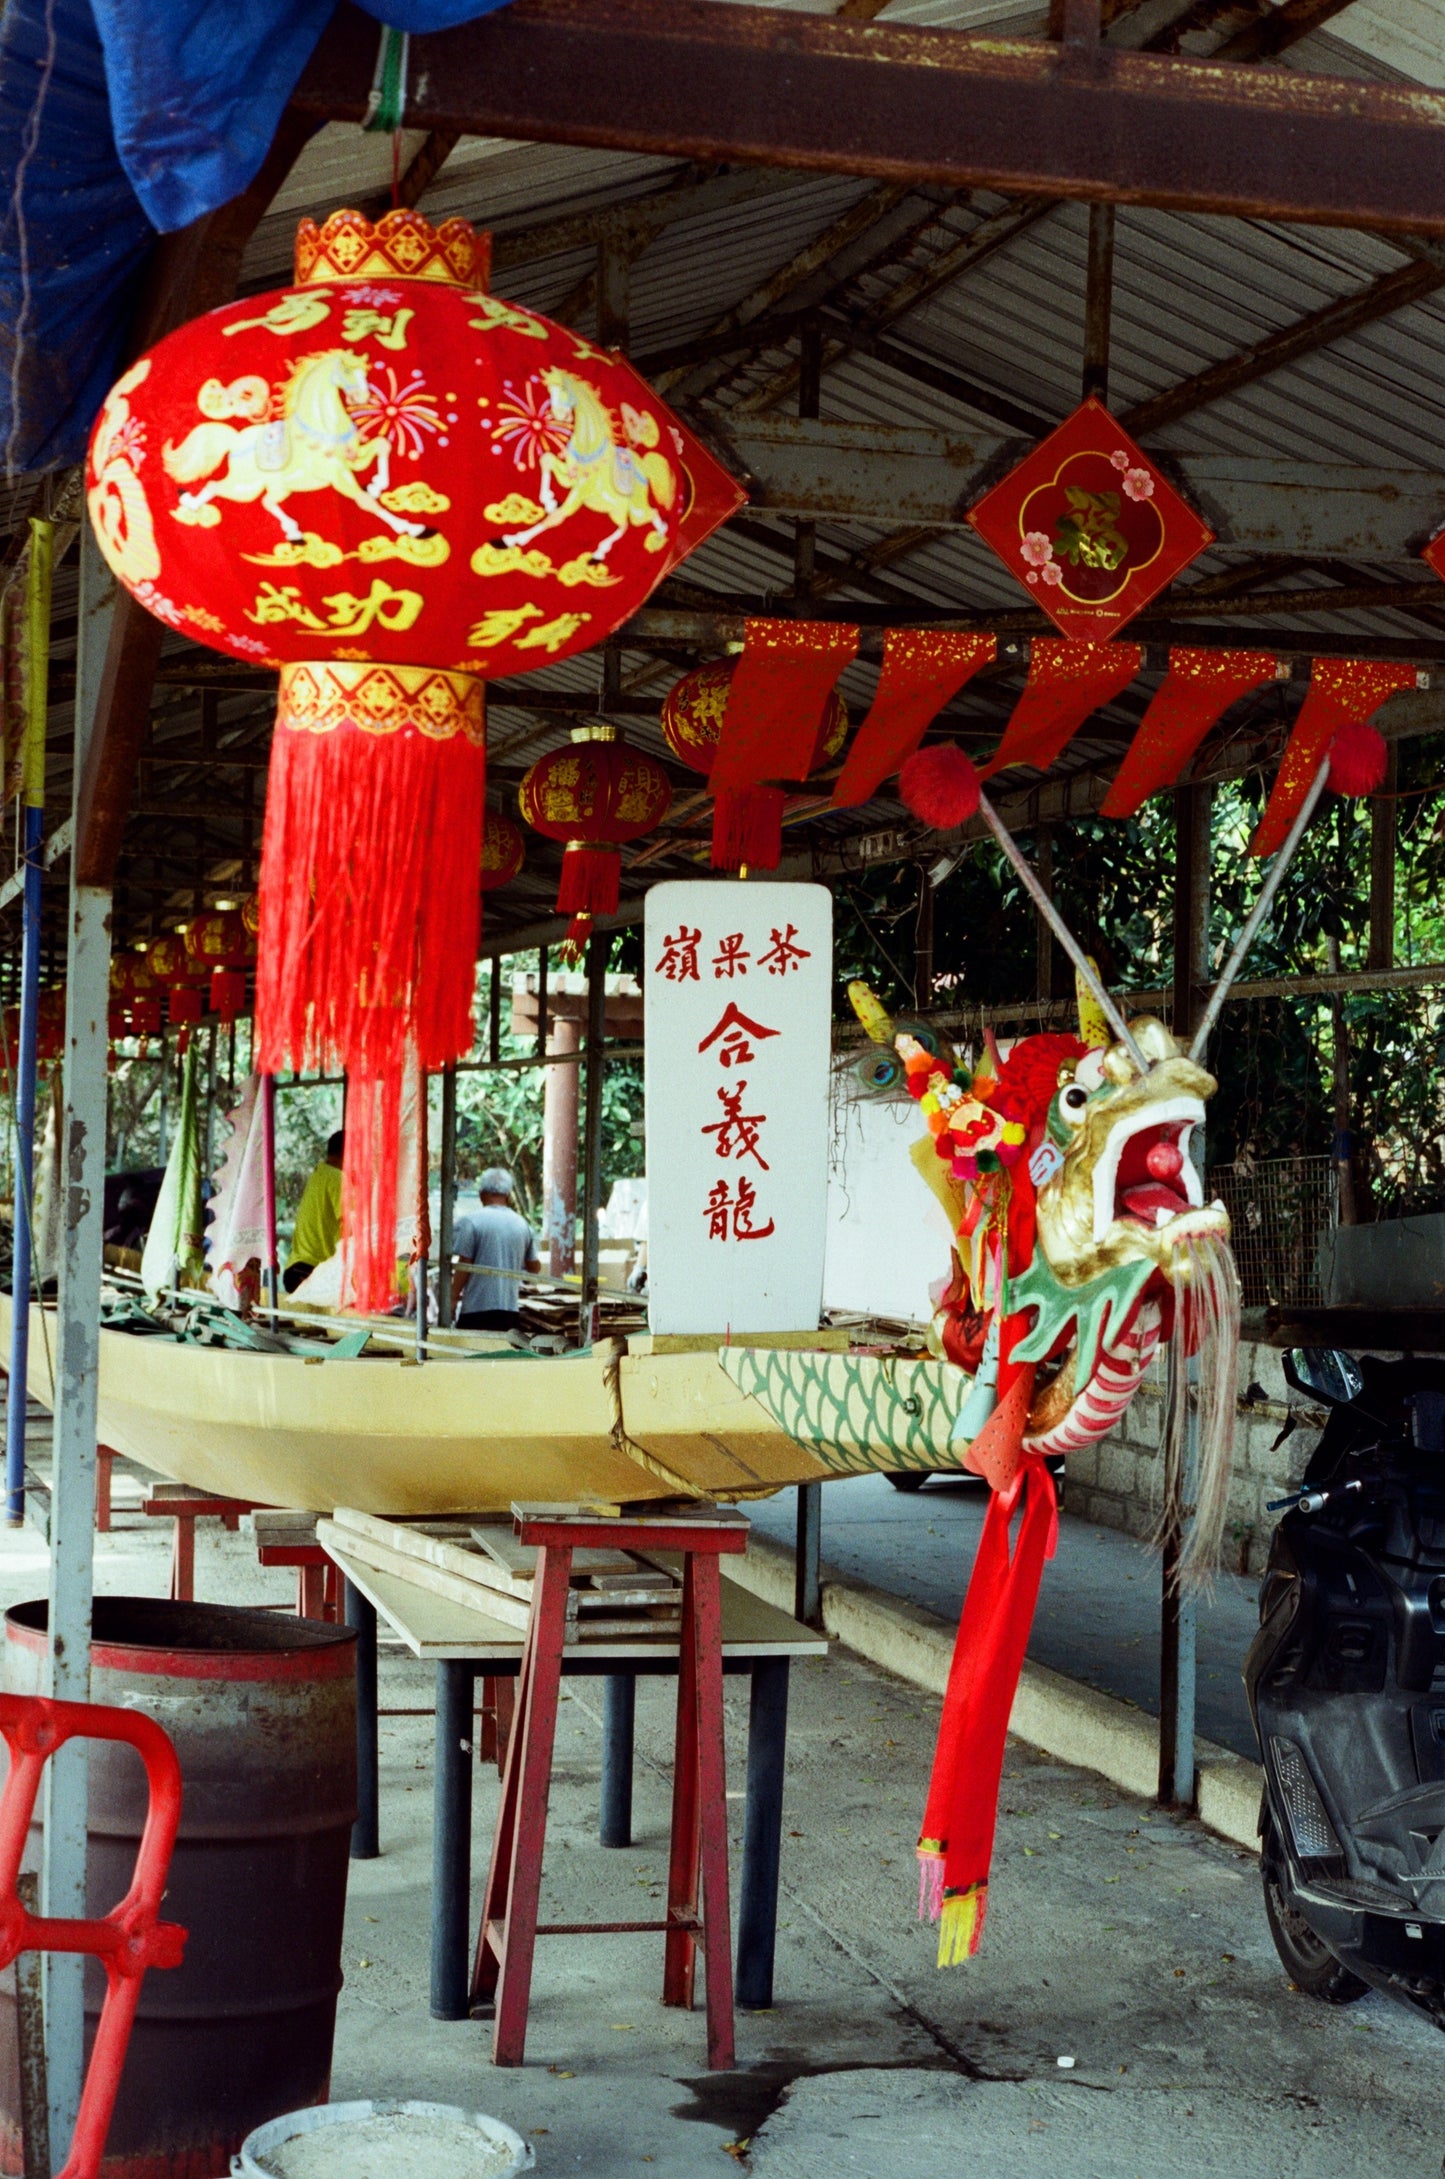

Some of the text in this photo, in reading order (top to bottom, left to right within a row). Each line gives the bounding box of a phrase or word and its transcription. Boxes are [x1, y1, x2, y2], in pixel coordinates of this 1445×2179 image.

[1052, 485, 1130, 571] 福
[242, 577, 425, 637] 成功
[655, 924, 811, 983] 茶果嶺
[698, 1001, 782, 1242] 合義龍
